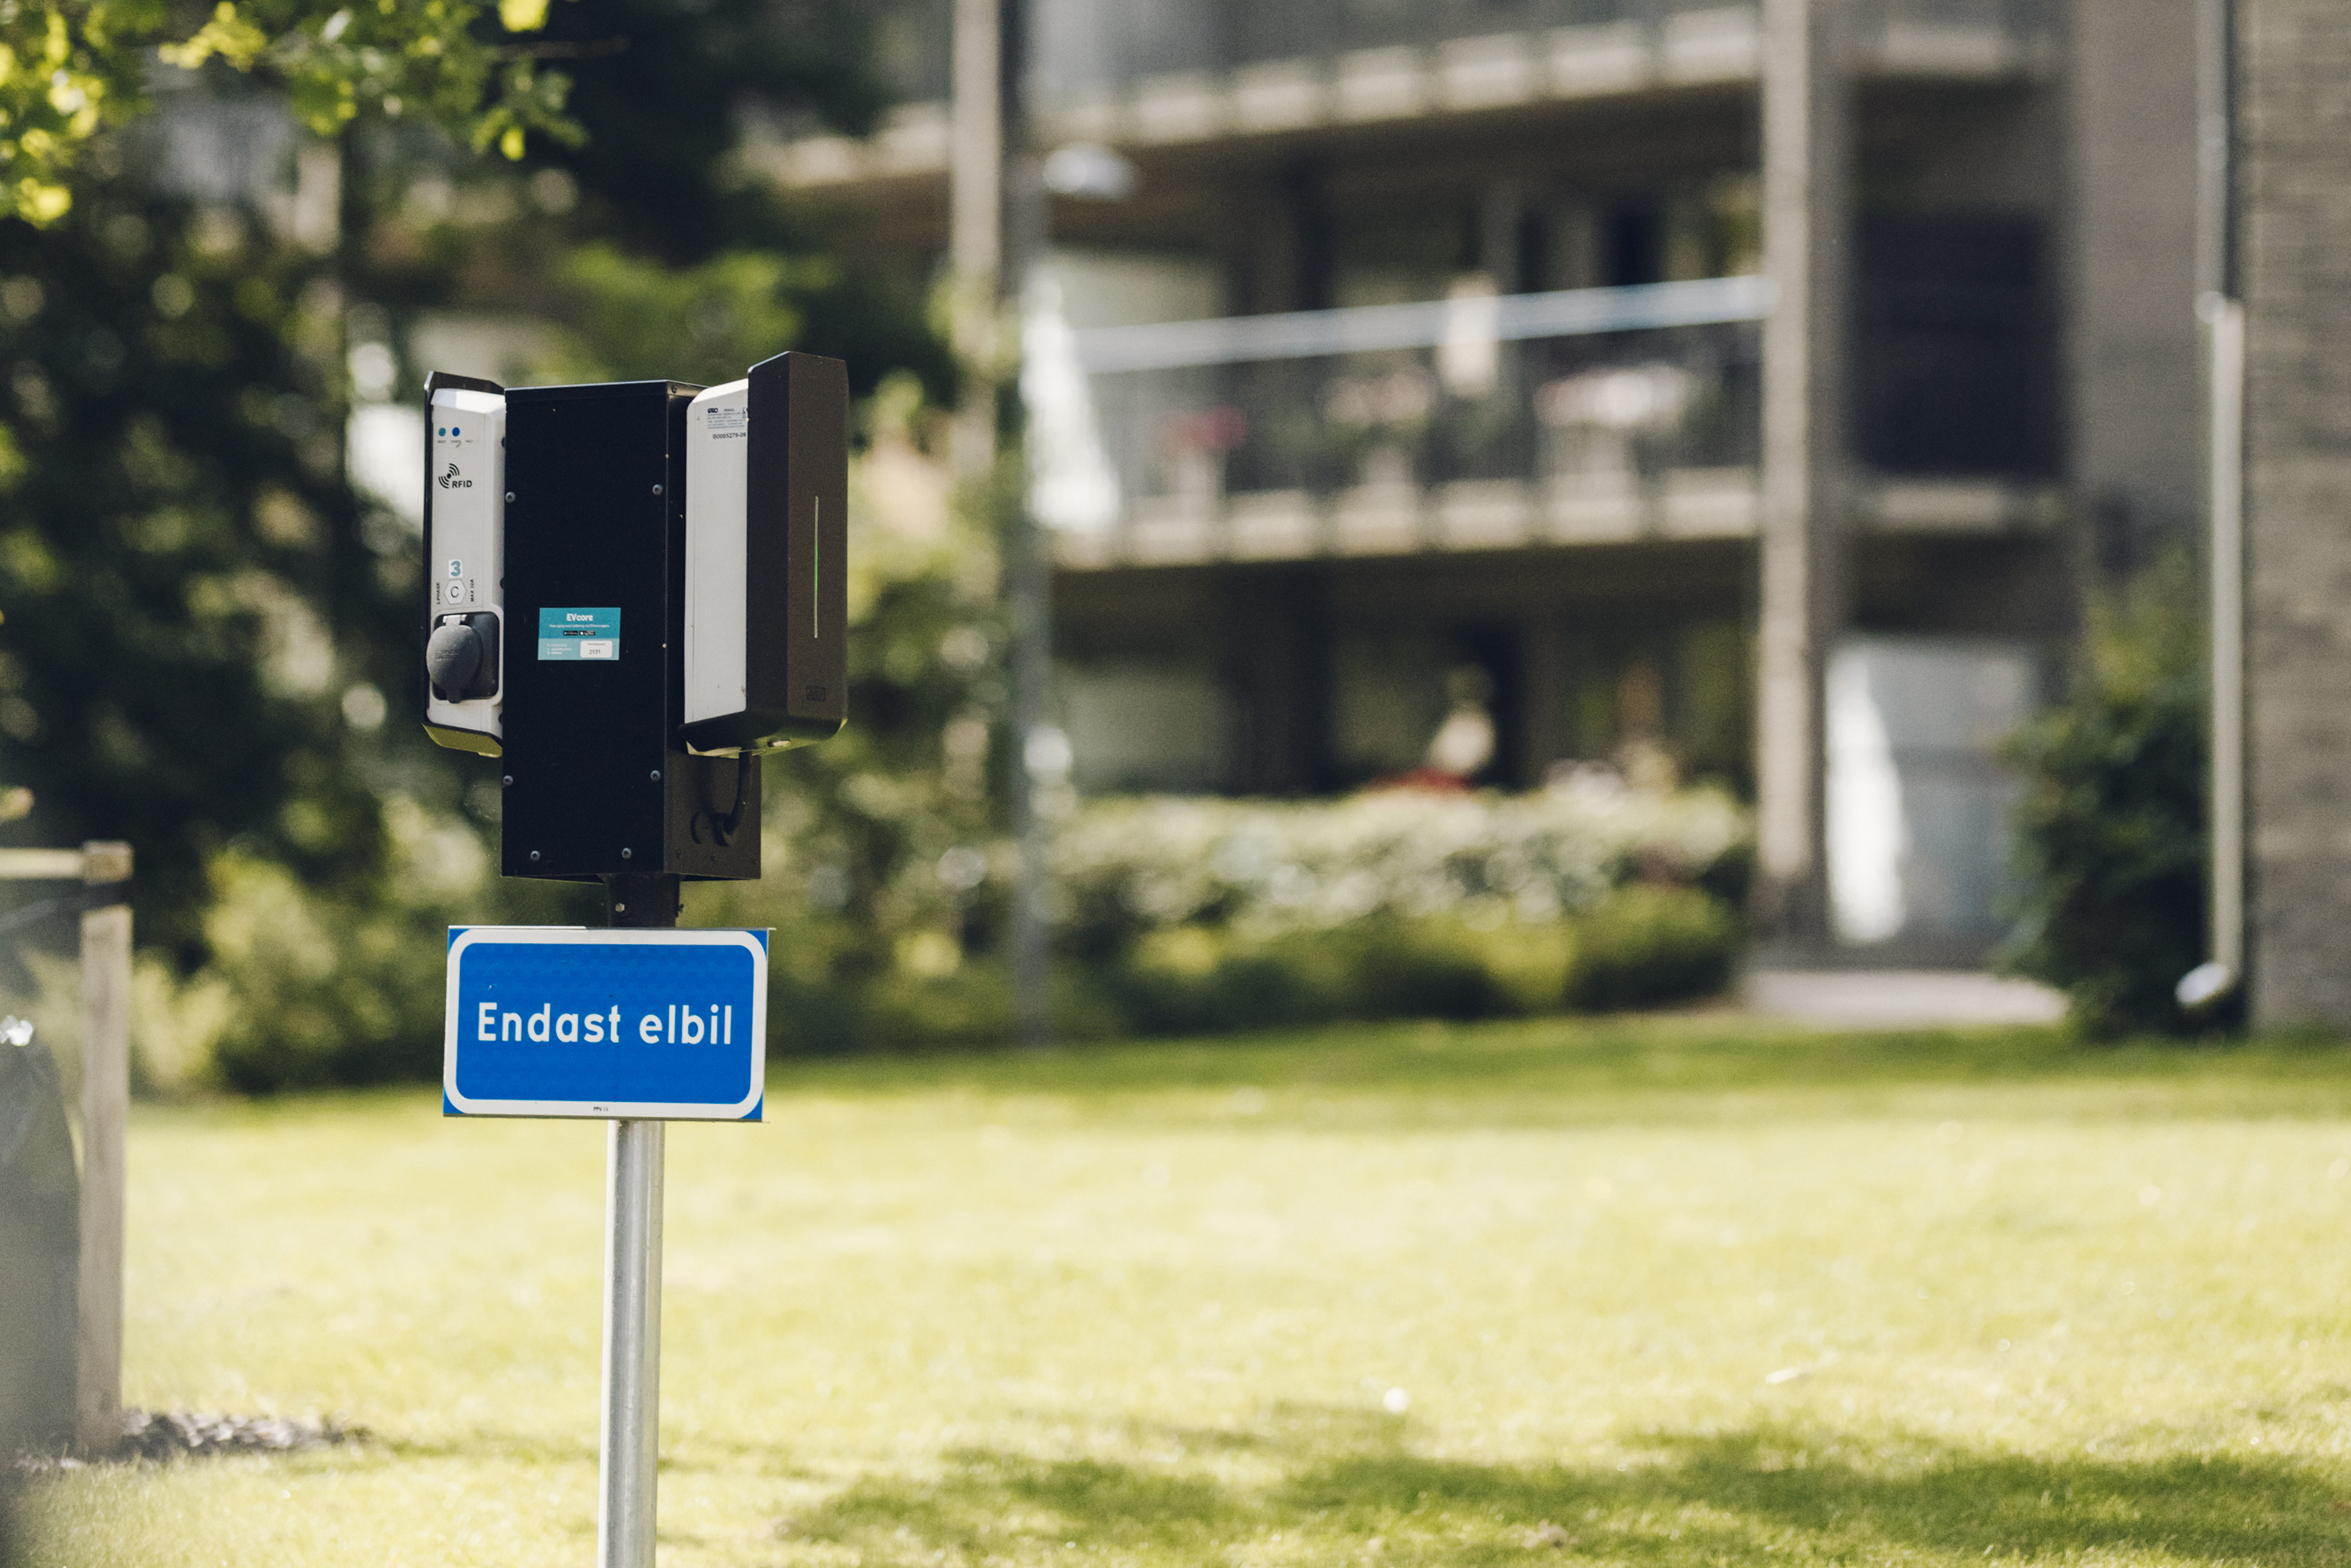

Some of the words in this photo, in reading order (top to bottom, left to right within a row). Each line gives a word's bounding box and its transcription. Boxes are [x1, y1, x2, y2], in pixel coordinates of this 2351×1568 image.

[452, 480, 473, 488] RFID
[451, 561, 461, 577] 3
[451, 587, 459, 598] C
[478, 1002, 621, 1043] Endast
[639, 1004, 732, 1045] elbil
